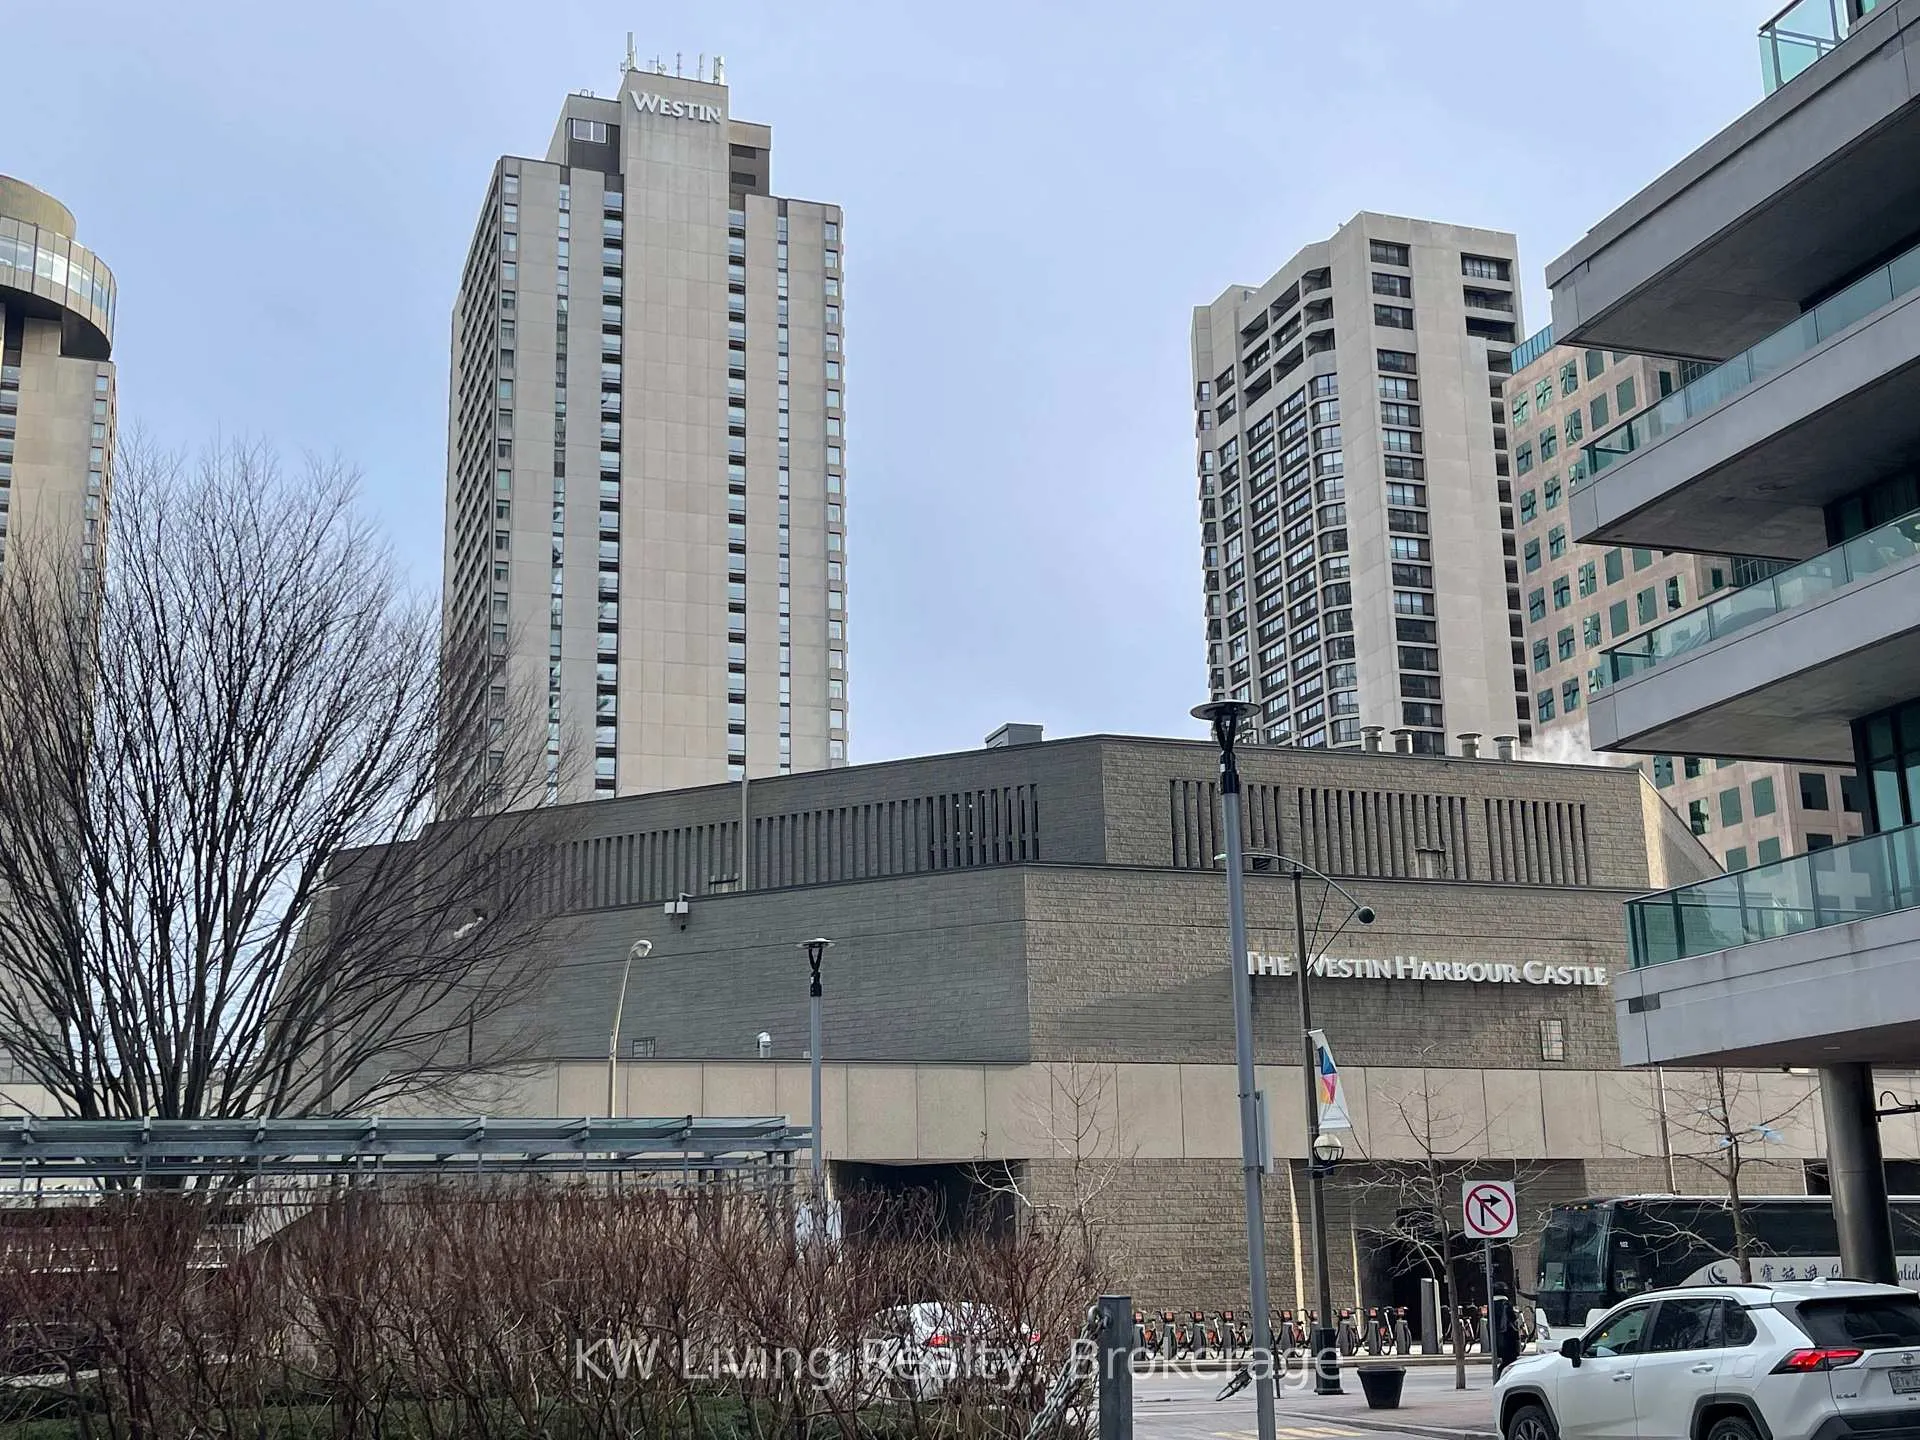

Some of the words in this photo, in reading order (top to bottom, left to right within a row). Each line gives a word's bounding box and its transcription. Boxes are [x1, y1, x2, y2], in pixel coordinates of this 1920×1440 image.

[630, 90, 722, 124] WESTIN
[1246, 951, 1293, 976] THE
[1395, 955, 1521, 983] HARBOUR
[1522, 960, 1609, 985] CASTLE
